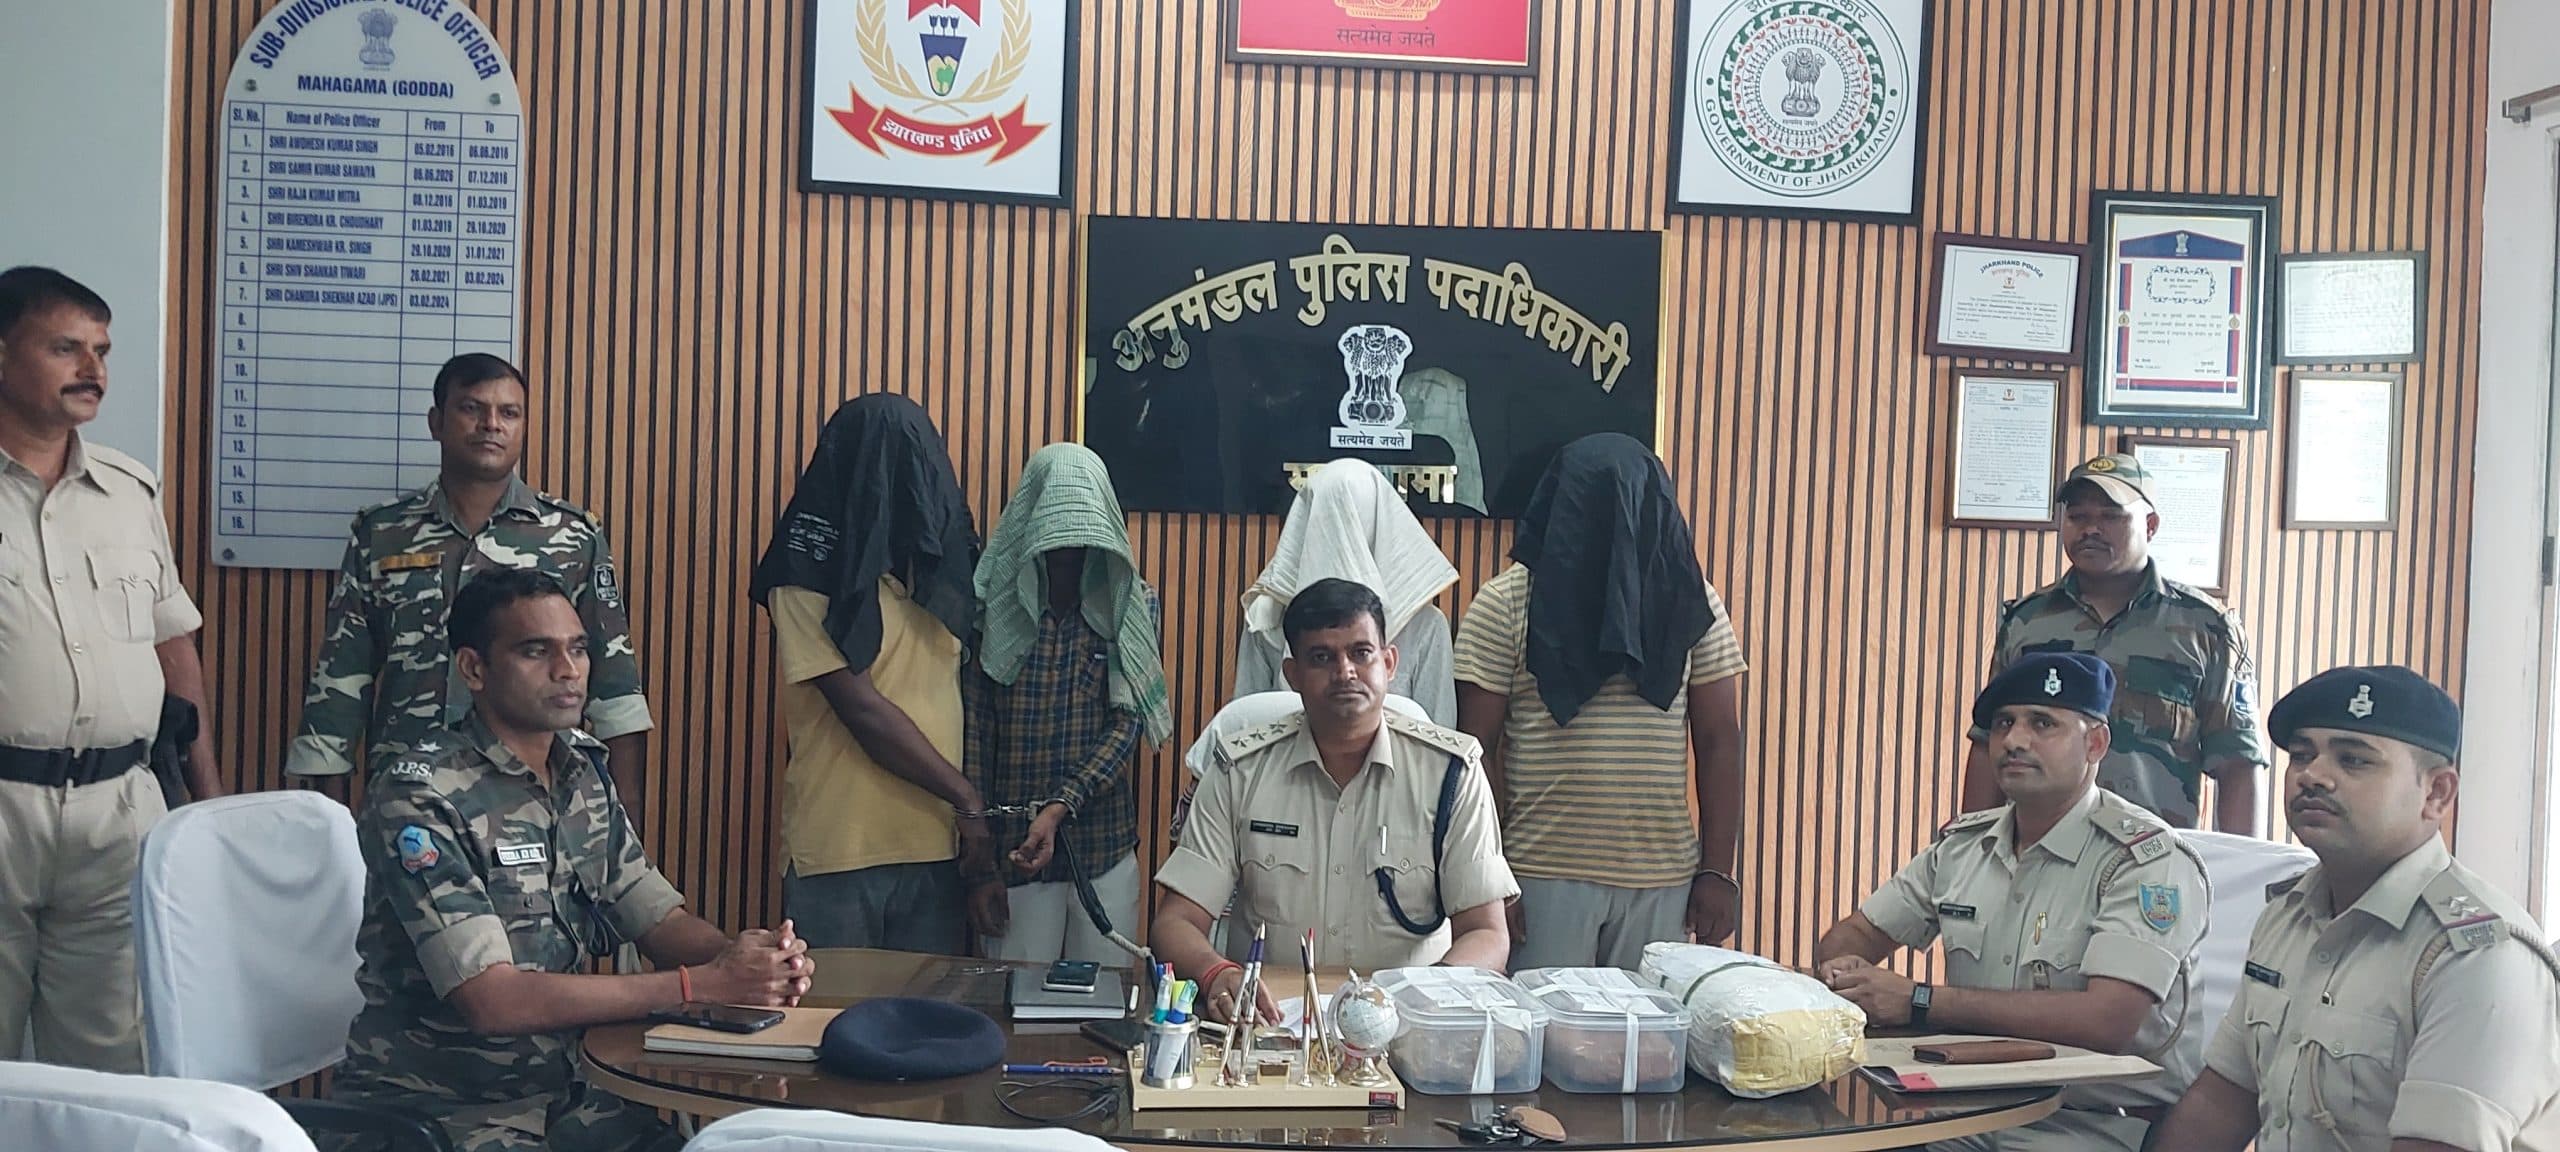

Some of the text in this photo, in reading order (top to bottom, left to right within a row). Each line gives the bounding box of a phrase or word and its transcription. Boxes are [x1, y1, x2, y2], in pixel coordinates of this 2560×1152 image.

[1336, 24, 1436, 48] सत्यमेव जयते
[443, 11, 501, 80] OFFICER
[297, 75, 454, 99] MAHAGAMA (GODDA)
[286, 110, 381, 129] Name of Police Officer
[425, 117, 446, 131] From
[485, 120, 494, 133] To
[244, 135, 250, 147] 1.
[881, 118, 992, 151] झारखण्ड पुलिस
[269, 135, 287, 148] SHRI
[327, 138, 353, 152] KUMAR
[356, 140, 378, 153] SINGH
[1705, 98, 1896, 187] GOVERNMENT OF JHARKHAND
[242, 160, 250, 173] 2.
[269, 161, 286, 174] SHRI
[288, 161, 312, 175] SAMIR
[314, 163, 341, 177] KUMAR
[241, 185, 249, 198] 3.
[268, 186, 360, 203] SHRI RAJA KUMAR MITRA
[241, 211, 248, 224] 4.
[267, 212, 284, 225] SHRI
[240, 236, 248, 249] 5.
[266, 237, 283, 250] SHRI
[349, 241, 372, 254] SINGH
[239, 261, 247, 274] 6.
[266, 262, 283, 276] SHRI
[304, 263, 338, 278] SHANKAR
[340, 265, 365, 279] TIWARI
[239, 287, 247, 300] 7.
[265, 288, 282, 301] SHRI
[284, 288, 320, 303] CHANDRA
[357, 292, 376, 305] AZAD
[238, 312, 246, 325] 8.
[1111, 233, 1631, 394] अनुमंडल पुलिस पदाधिकारी
[237, 338, 246, 351] 9.
[235, 363, 248, 377] 10.
[234, 388, 247, 402] 11.
[233, 414, 247, 428] 12.
[1336, 430, 1405, 447] सत्यमेव जयते
[232, 440, 246, 453] 13.
[232, 465, 245, 479] 14.
[232, 491, 245, 504] 15.
[231, 516, 244, 530] 16.
